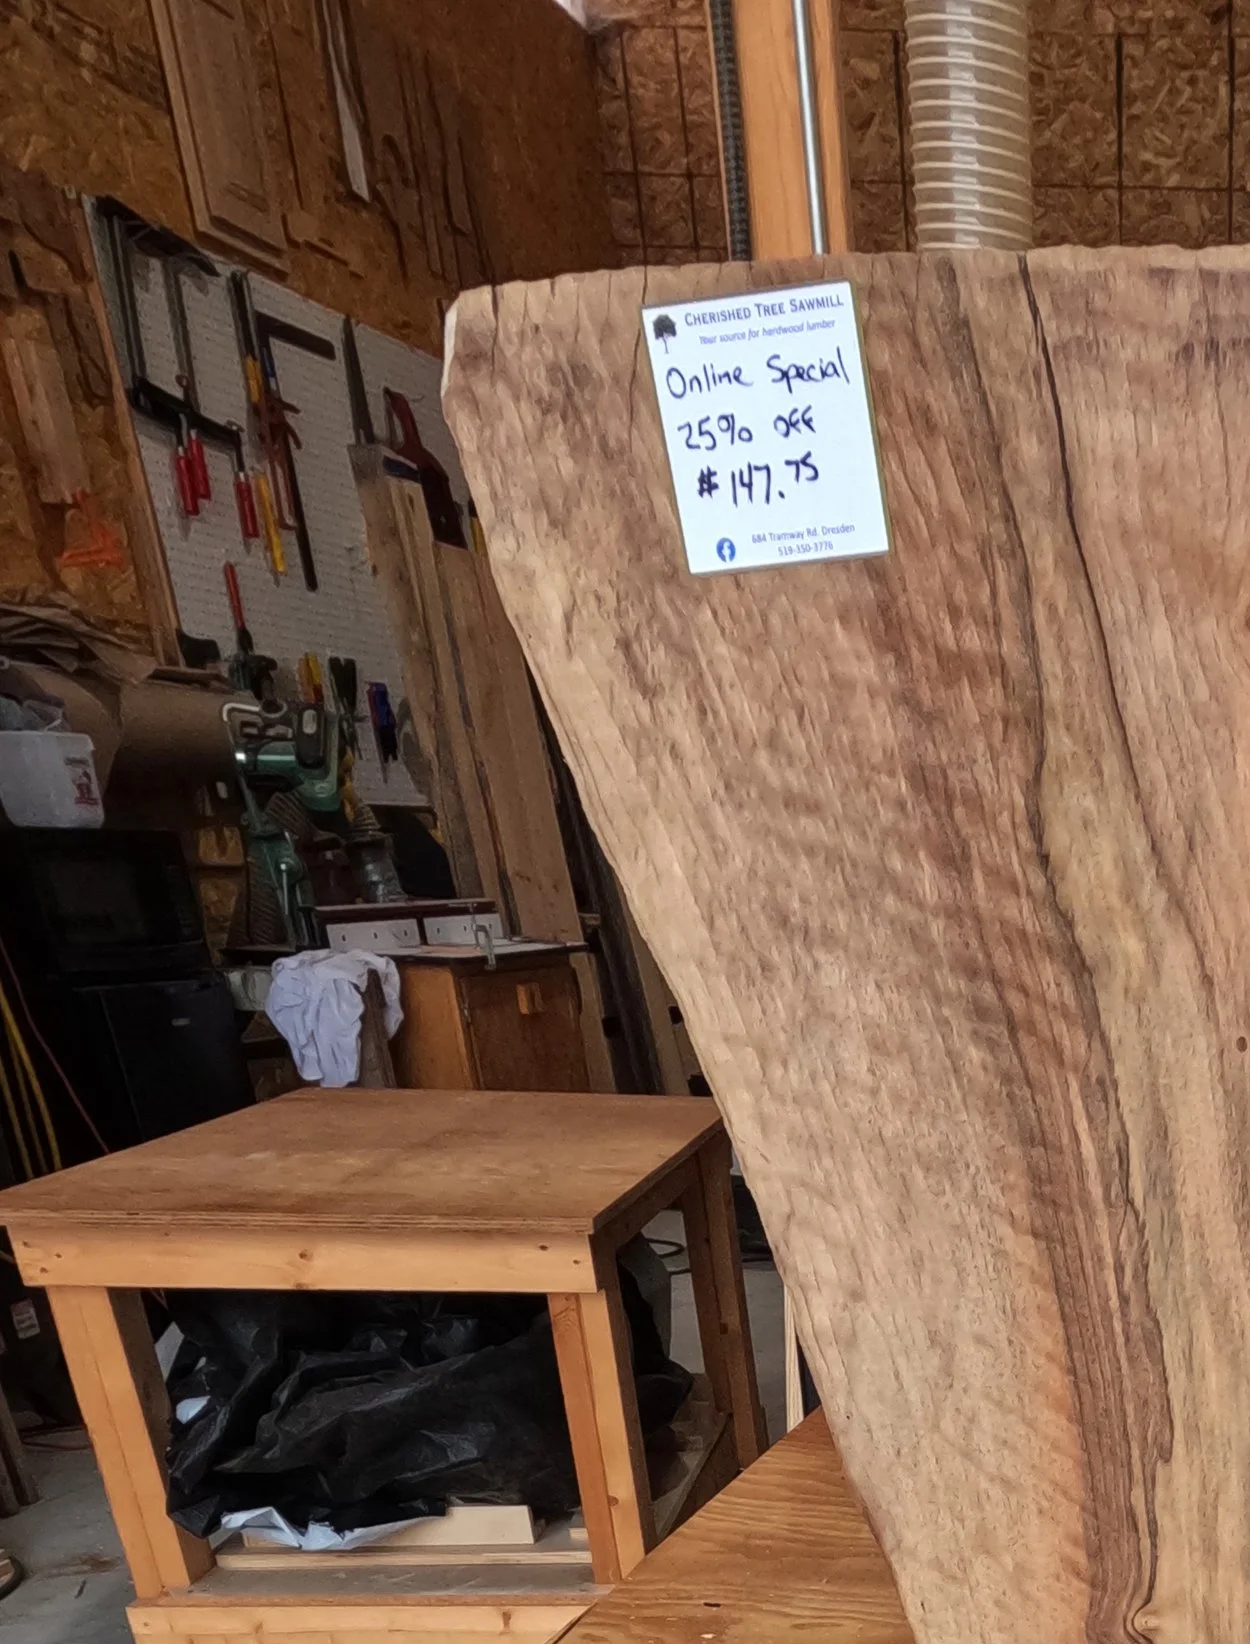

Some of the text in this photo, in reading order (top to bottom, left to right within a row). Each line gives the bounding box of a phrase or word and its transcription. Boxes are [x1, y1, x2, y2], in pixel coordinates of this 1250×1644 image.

[684, 294, 844, 326] CHERISHED TREE SAWMILL
[719, 331, 746, 342] source
[748, 328, 760, 341] for
[762, 322, 804, 336] hardwood
[806, 319, 836, 330] lumber
[666, 346, 850, 399] Online Special
[677, 413, 753, 450] 25%
[821, 523, 855, 536] Dresden
